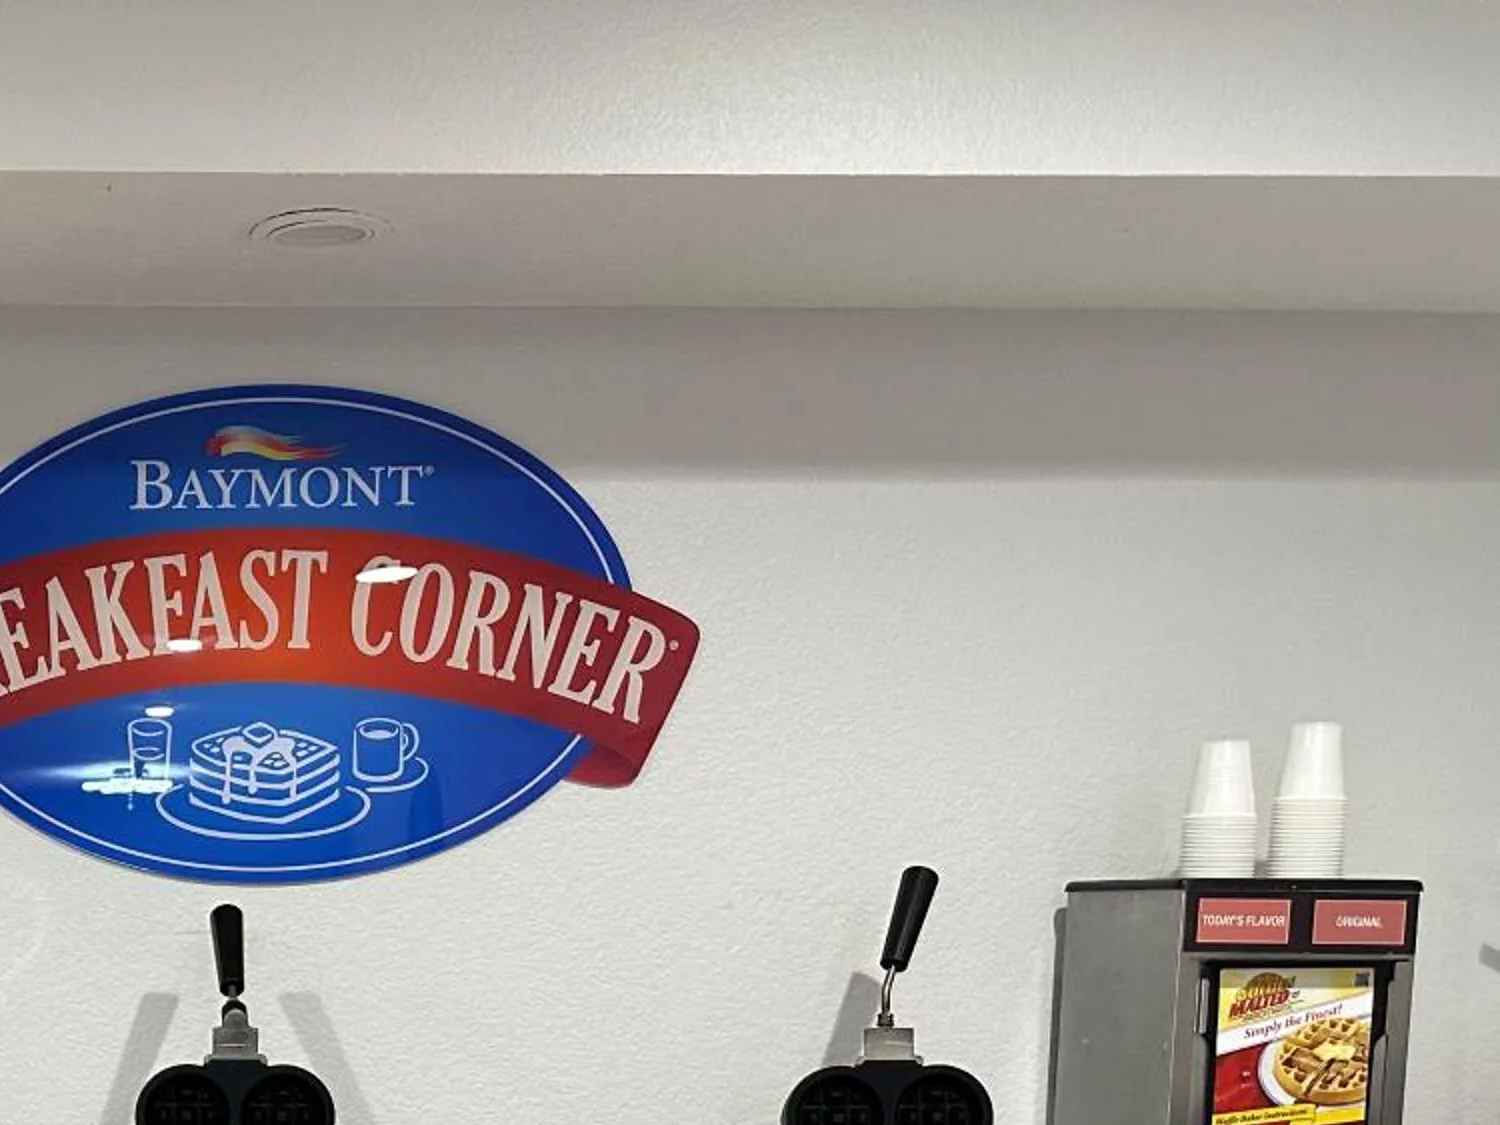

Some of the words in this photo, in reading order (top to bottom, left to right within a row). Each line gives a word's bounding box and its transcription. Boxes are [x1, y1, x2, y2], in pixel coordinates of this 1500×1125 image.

[129, 459, 425, 510] BAYMONT
[350, 553, 668, 726] CORNER
[1203, 915, 1244, 927] TODAY'S
[1245, 915, 1285, 927] FLAVOR
[1228, 989, 1290, 1019] MALTED
